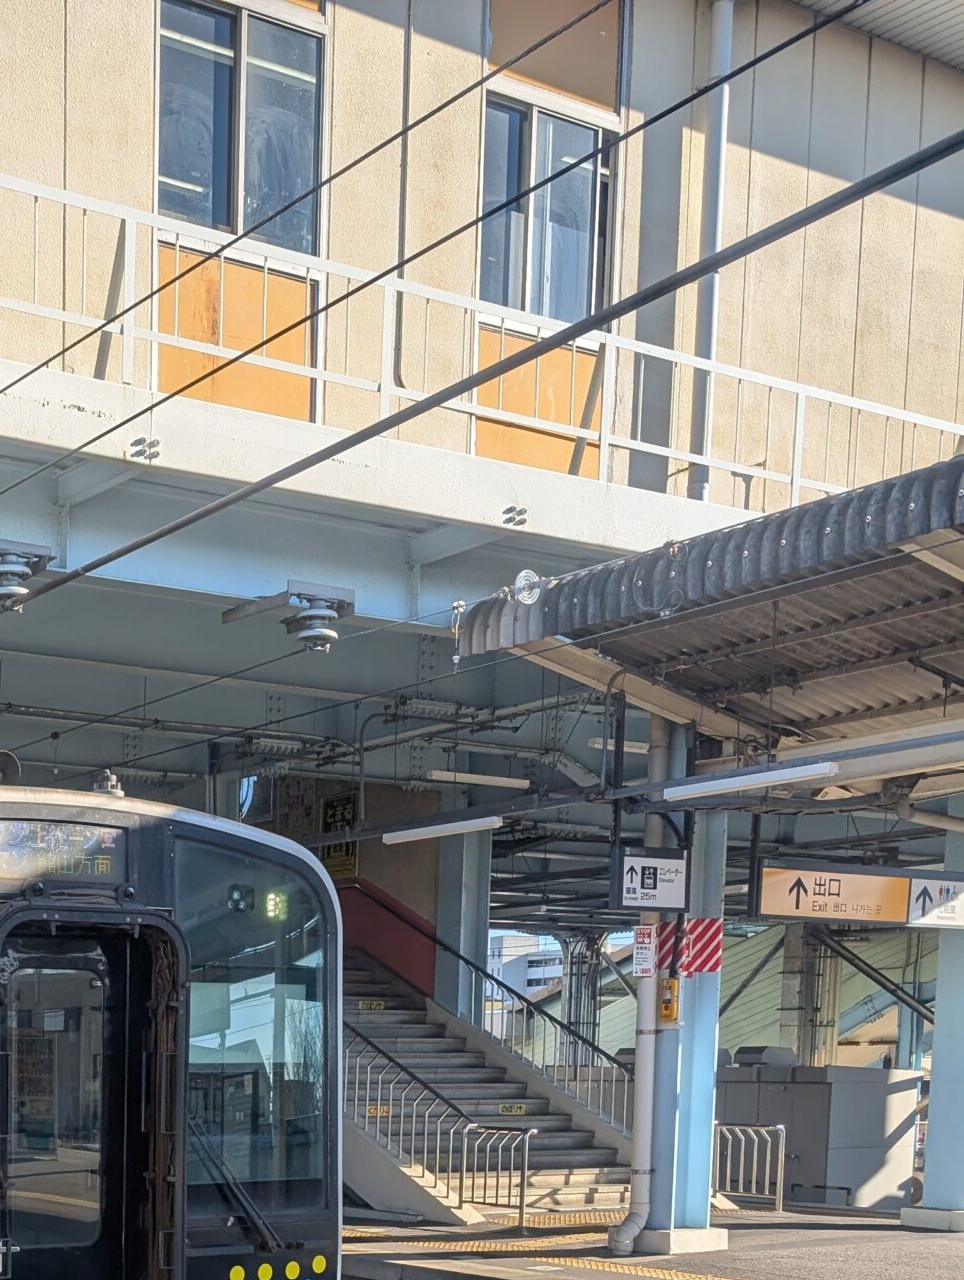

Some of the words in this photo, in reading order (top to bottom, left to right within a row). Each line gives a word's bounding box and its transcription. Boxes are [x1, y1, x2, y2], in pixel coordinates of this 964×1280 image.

[813, 876, 842, 898] 出口
[640, 891, 657, 901] 25m
[811, 900, 828, 913] Exit
[832, 902, 847, 913] 出口
